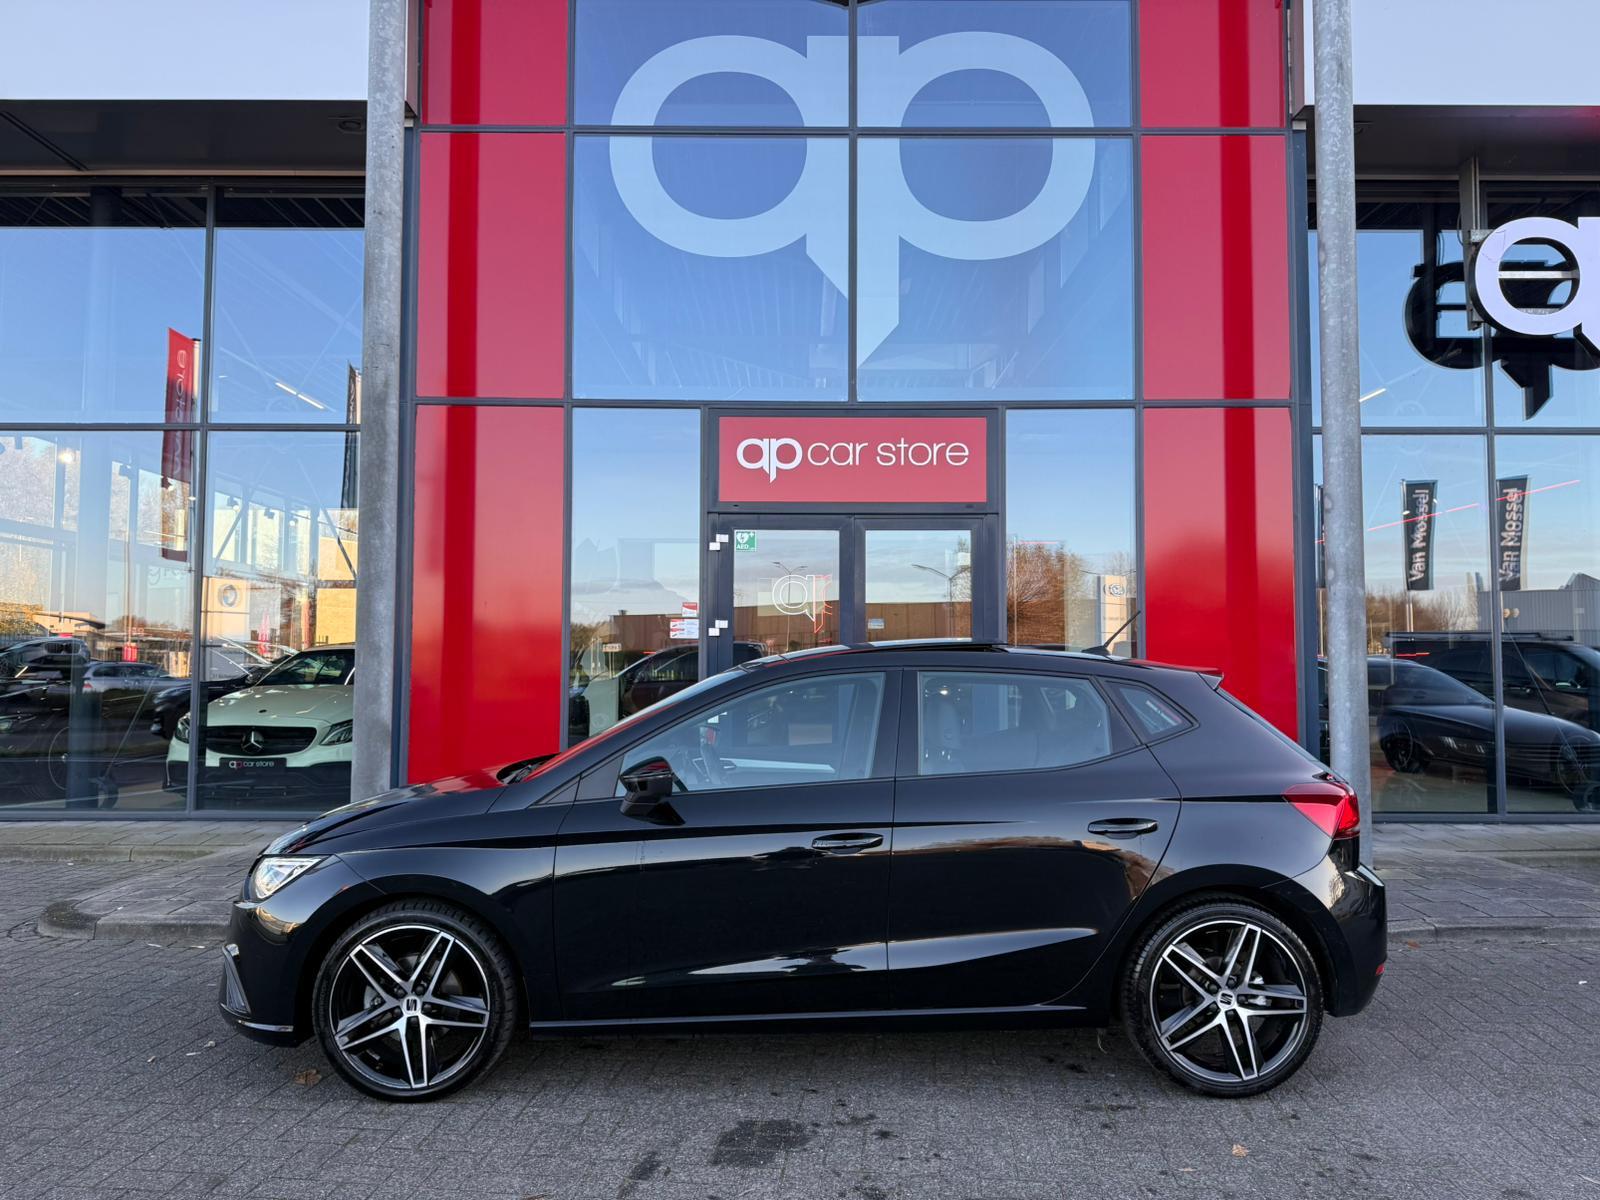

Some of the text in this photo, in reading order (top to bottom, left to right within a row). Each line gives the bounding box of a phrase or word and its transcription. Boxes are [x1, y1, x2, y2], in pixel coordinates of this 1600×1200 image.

[736, 437, 969, 484] ap car store
[1408, 552, 1426, 582] Van
